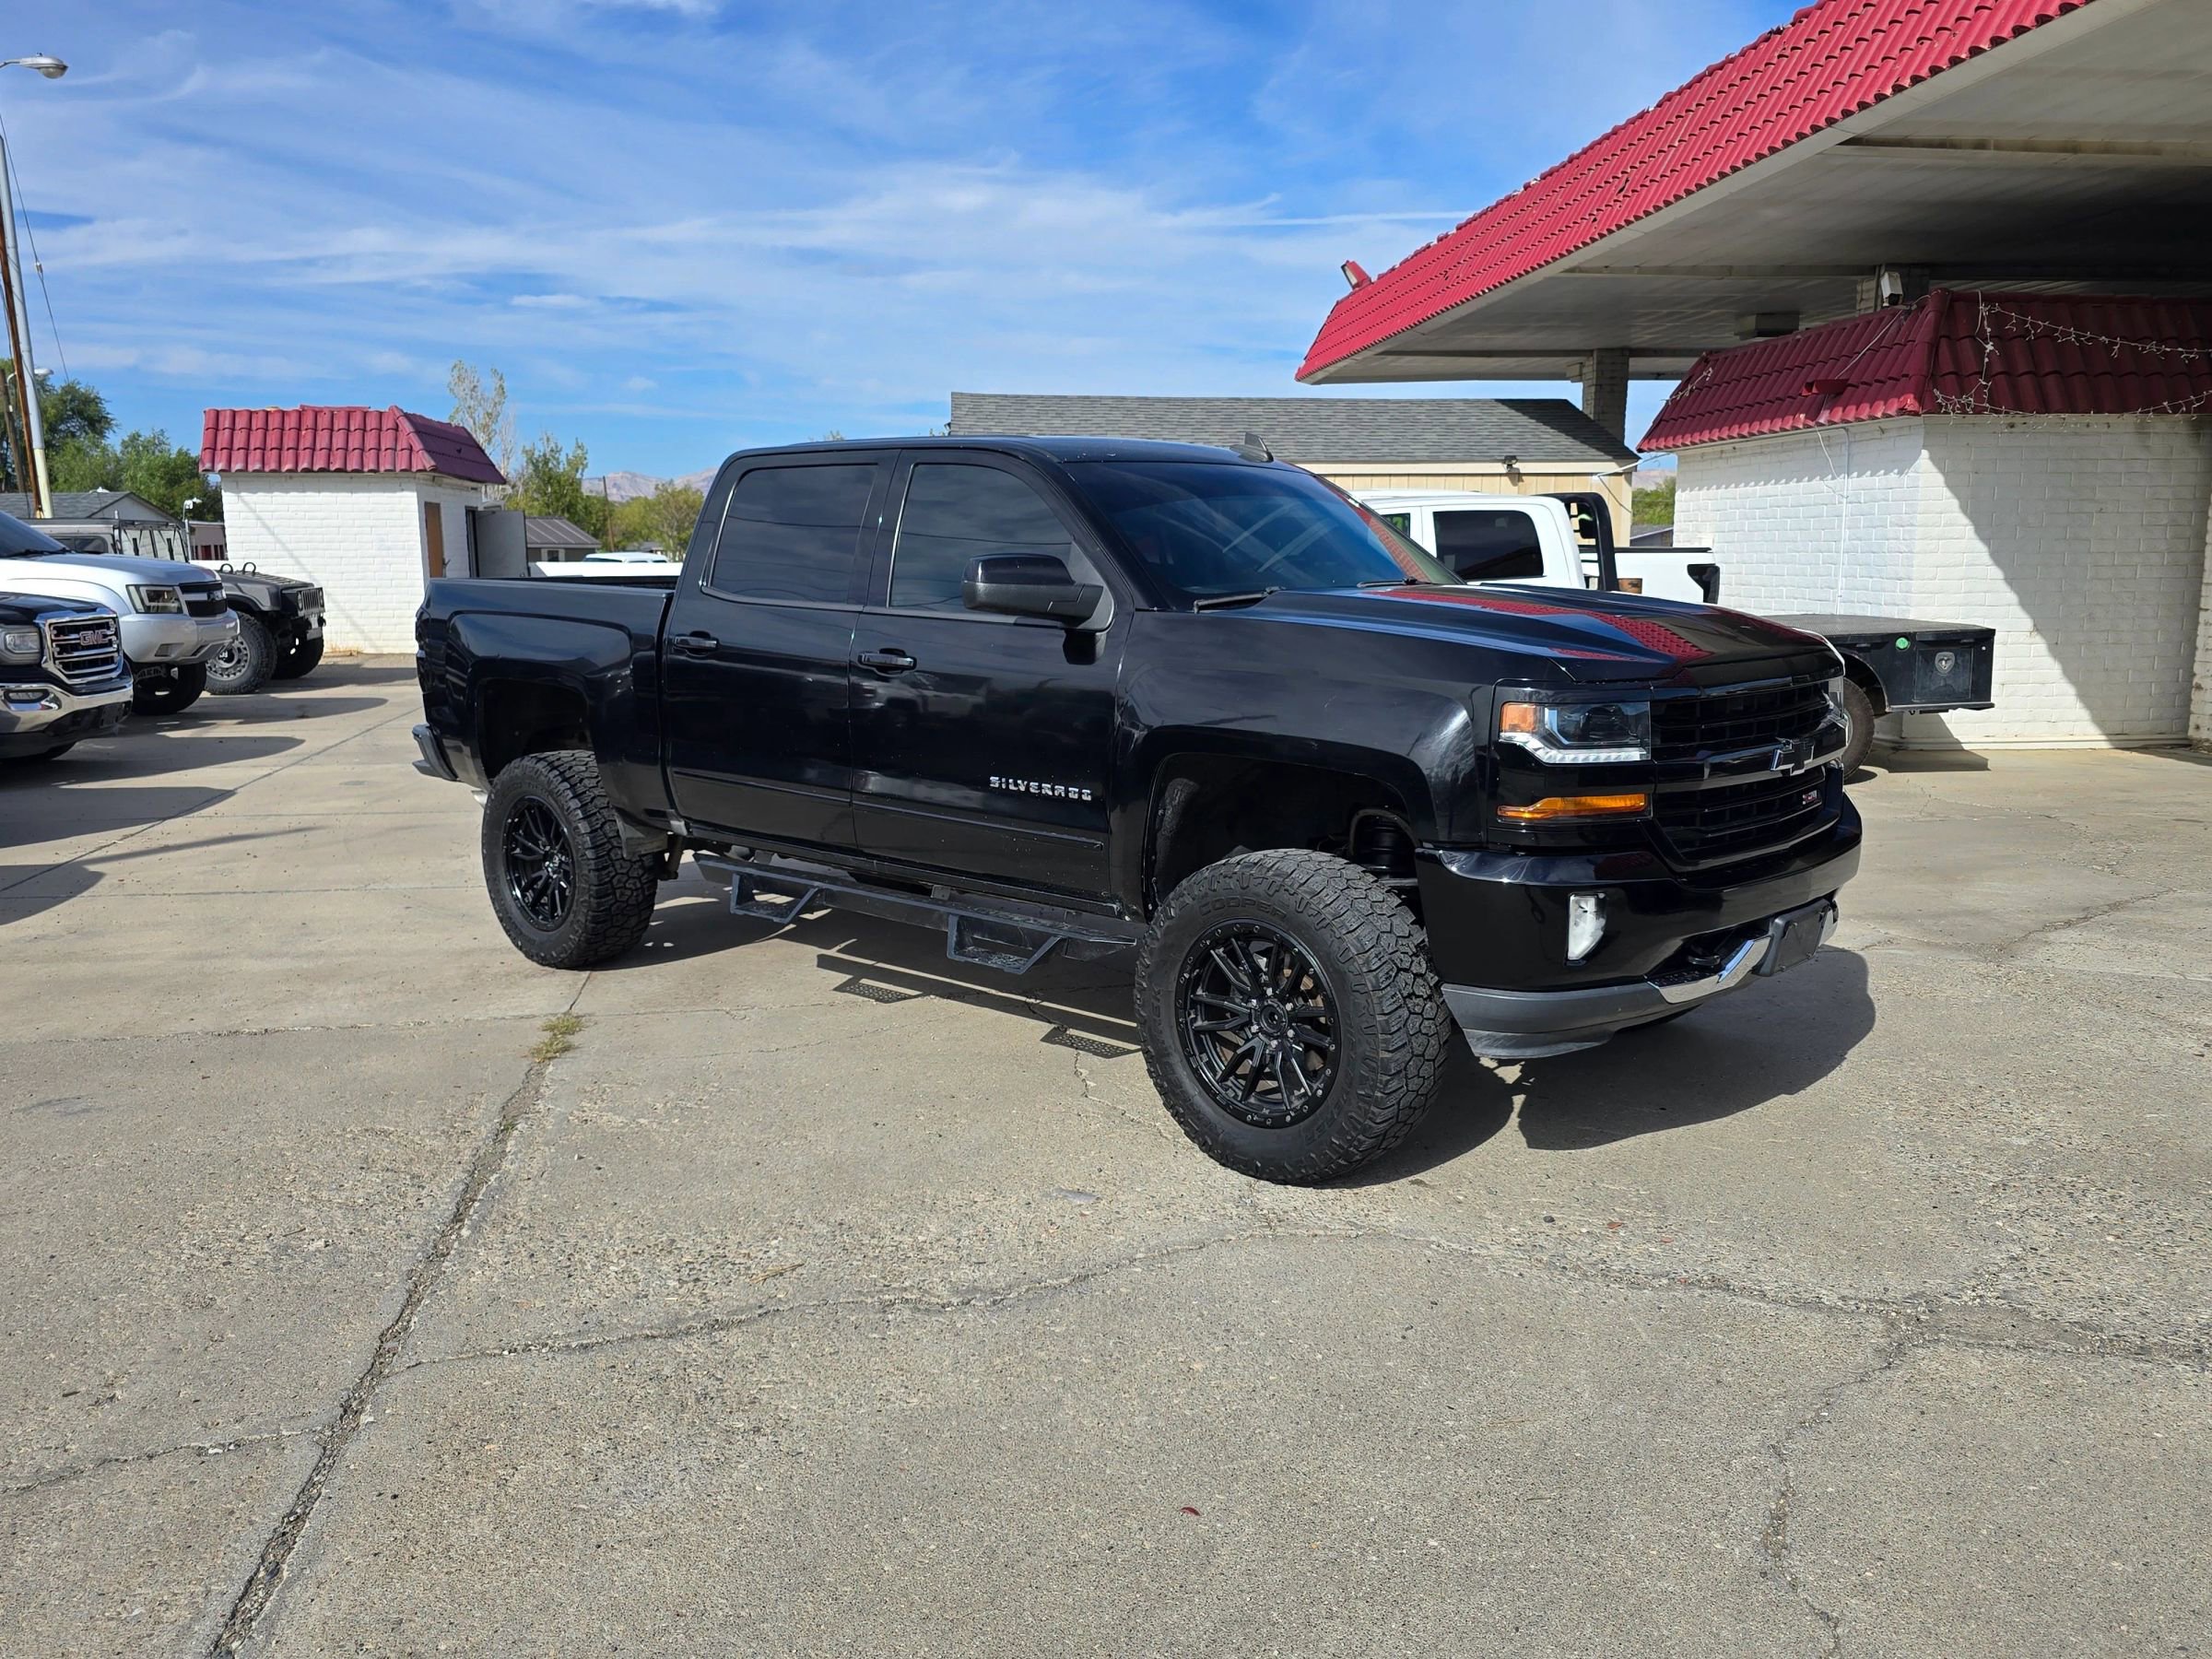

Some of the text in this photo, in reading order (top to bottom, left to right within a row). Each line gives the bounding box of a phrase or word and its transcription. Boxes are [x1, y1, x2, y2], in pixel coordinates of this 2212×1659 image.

[79, 629, 109, 646] GMC
[989, 776, 1092, 801] SILVERADO
[1199, 895, 1288, 919] COOPER
